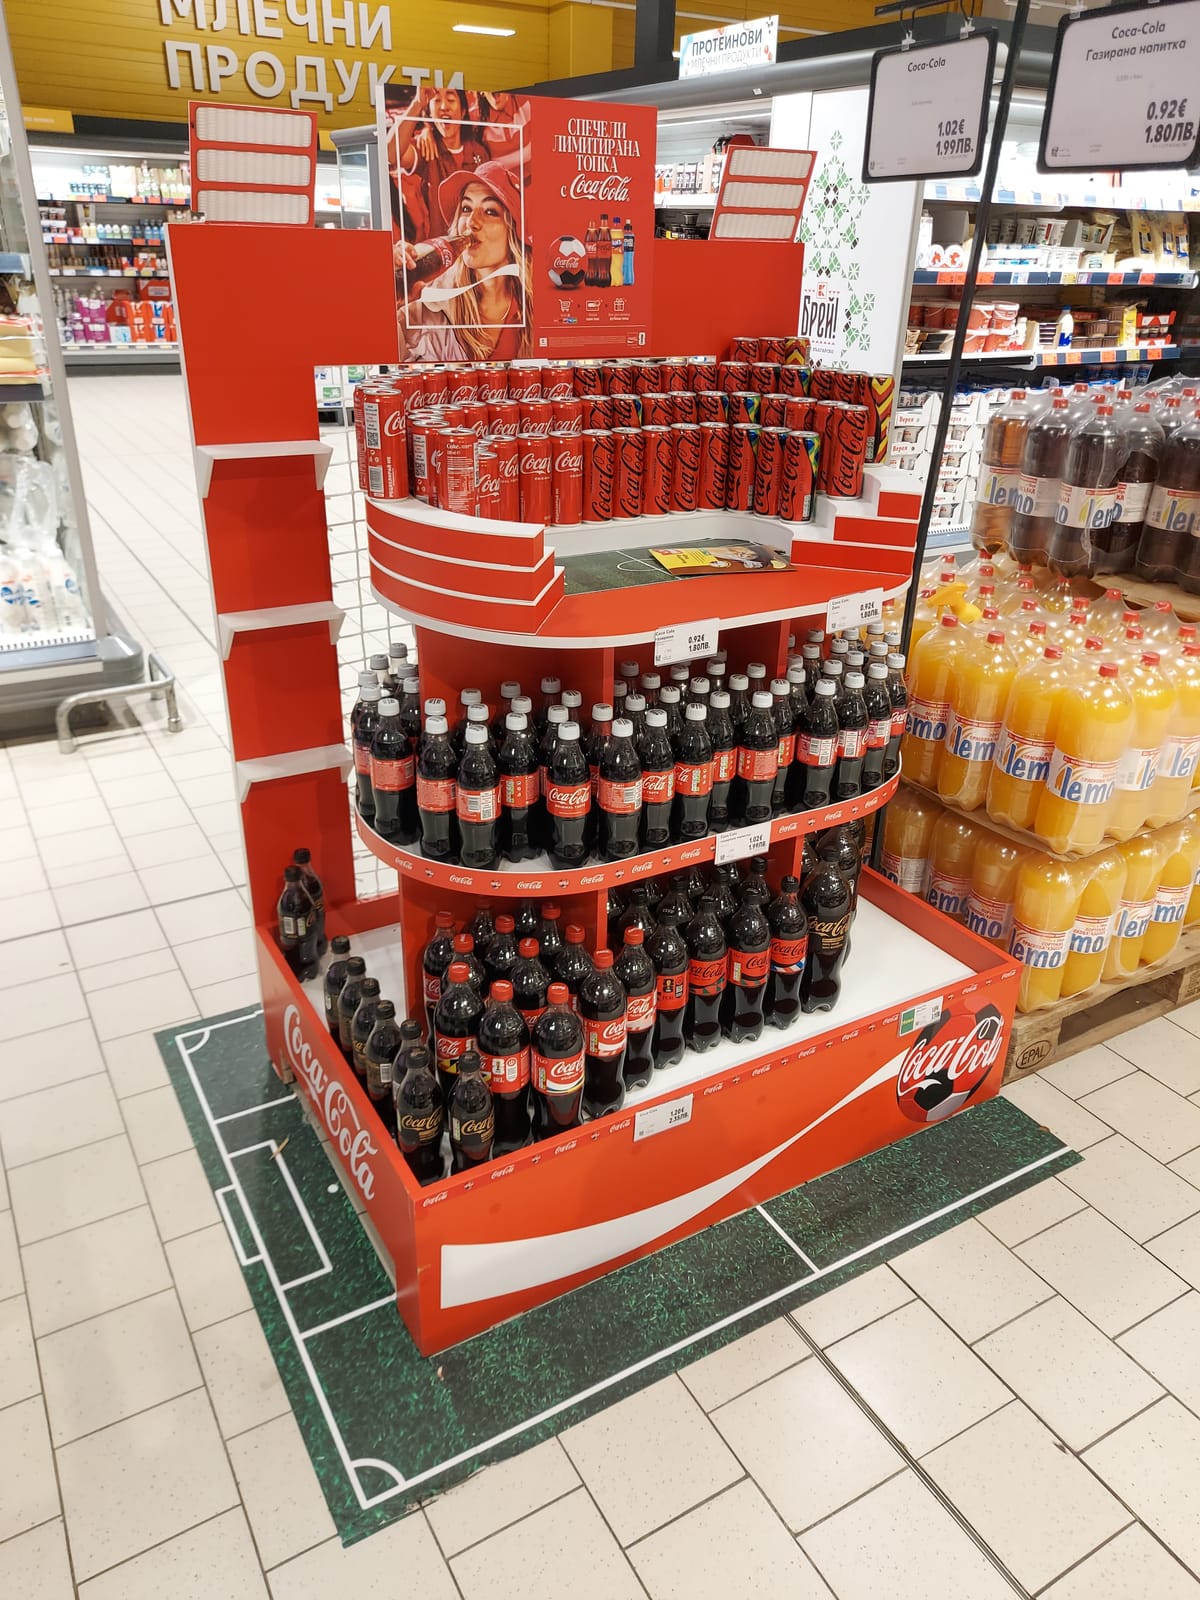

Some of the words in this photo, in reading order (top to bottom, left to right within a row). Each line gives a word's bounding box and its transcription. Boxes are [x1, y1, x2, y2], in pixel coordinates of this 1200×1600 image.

[159, 0, 392, 51] МЛЕЧНИ
[1111, 20, 1166, 40] Coca-Cola
[692, 28, 763, 57] ПРОТЕИНОВИ
[1086, 46, 1137, 62] Газирана
[1139, 39, 1187, 55] напитка
[907, 57, 946, 73] Coca-Cola
[1146, 98, 1188, 121] 0.92€
[567, 117, 627, 139] СПЕЧЕЛИ
[937, 118, 965, 138] 1.02€
[1144, 121, 1196, 144] 1.80ЛВ.
[552, 134, 641, 157] ЛИМИТИРАНА
[935, 137, 974, 156] 1.99ЛВ.
[575, 154, 618, 173] ТОПКА
[569, 173, 633, 201] Coca-Cola
[800, 294, 839, 340] Брей!
[688, 633, 705, 644] 0.92€
[953, 725, 997, 761] lem
[1005, 743, 1050, 781] lem
[549, 785, 591, 805] Coca-Cola
[897, 1015, 1005, 1097] Coca-Cola
[1020, 1044, 1046, 1066] EPAL
[283, 1003, 378, 1201] Coca-Cola
